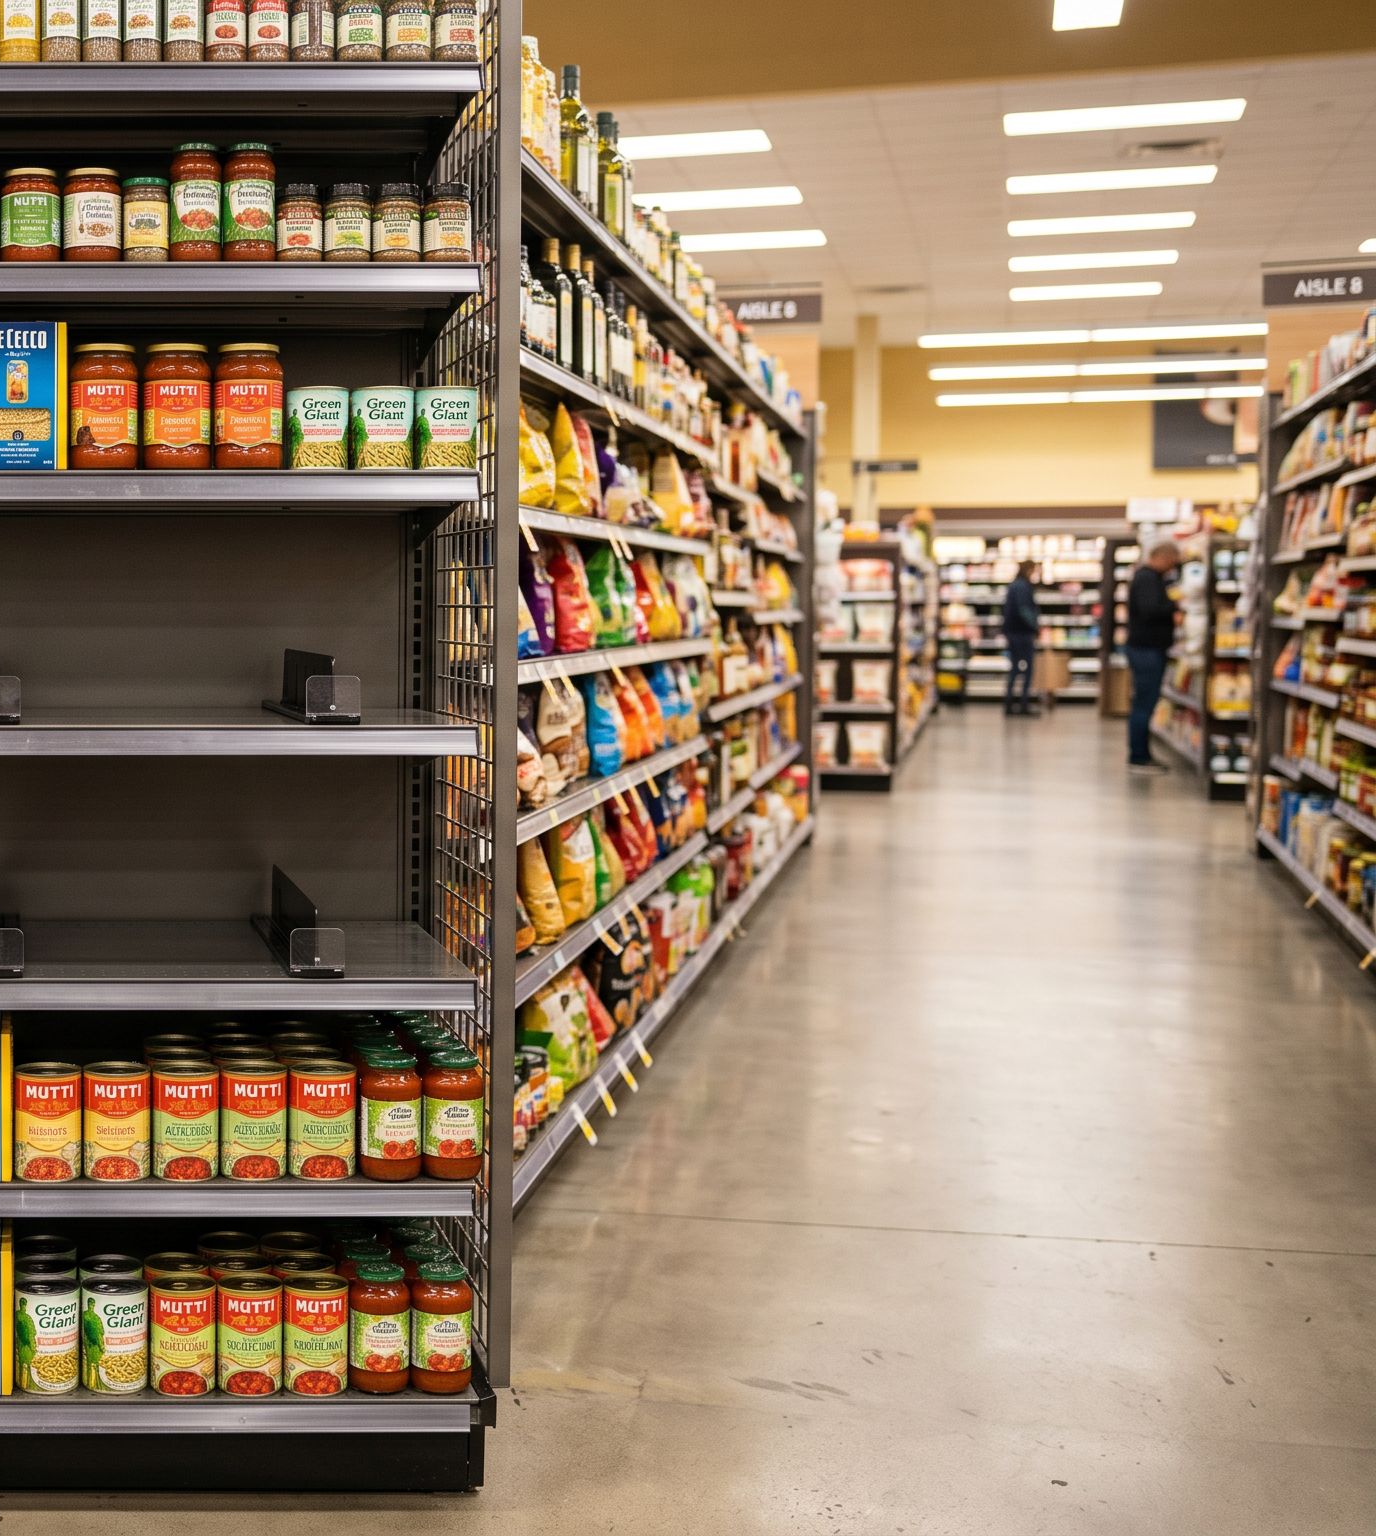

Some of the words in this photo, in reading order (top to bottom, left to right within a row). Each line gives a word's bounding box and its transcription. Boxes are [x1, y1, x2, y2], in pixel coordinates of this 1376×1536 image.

[1293, 277, 1347, 298] AISLE
[87, 385, 124, 396] MUTTI
[159, 385, 198, 396] MUTTI
[229, 384, 268, 396] MUTTI
[302, 398, 342, 409] Green
[366, 398, 406, 409] Green
[430, 398, 470, 409] Green
[368, 409, 404, 420] Giant
[432, 409, 468, 420] Giant
[25, 1084, 74, 1099] MUTTI
[94, 1083, 142, 1098] MUTTI
[165, 1084, 212, 1099] MUTTI
[234, 1083, 282, 1098] MUTTI
[303, 1083, 351, 1097] MUTTI
[35, 1301, 77, 1317] Green
[103, 1301, 145, 1316] Green
[160, 1299, 207, 1314] MUTTI
[228, 1299, 274, 1313] MUTTI
[295, 1299, 342, 1313] MUTTI
[38, 1313, 76, 1329] Giant
[107, 1312, 144, 1328] Giant
